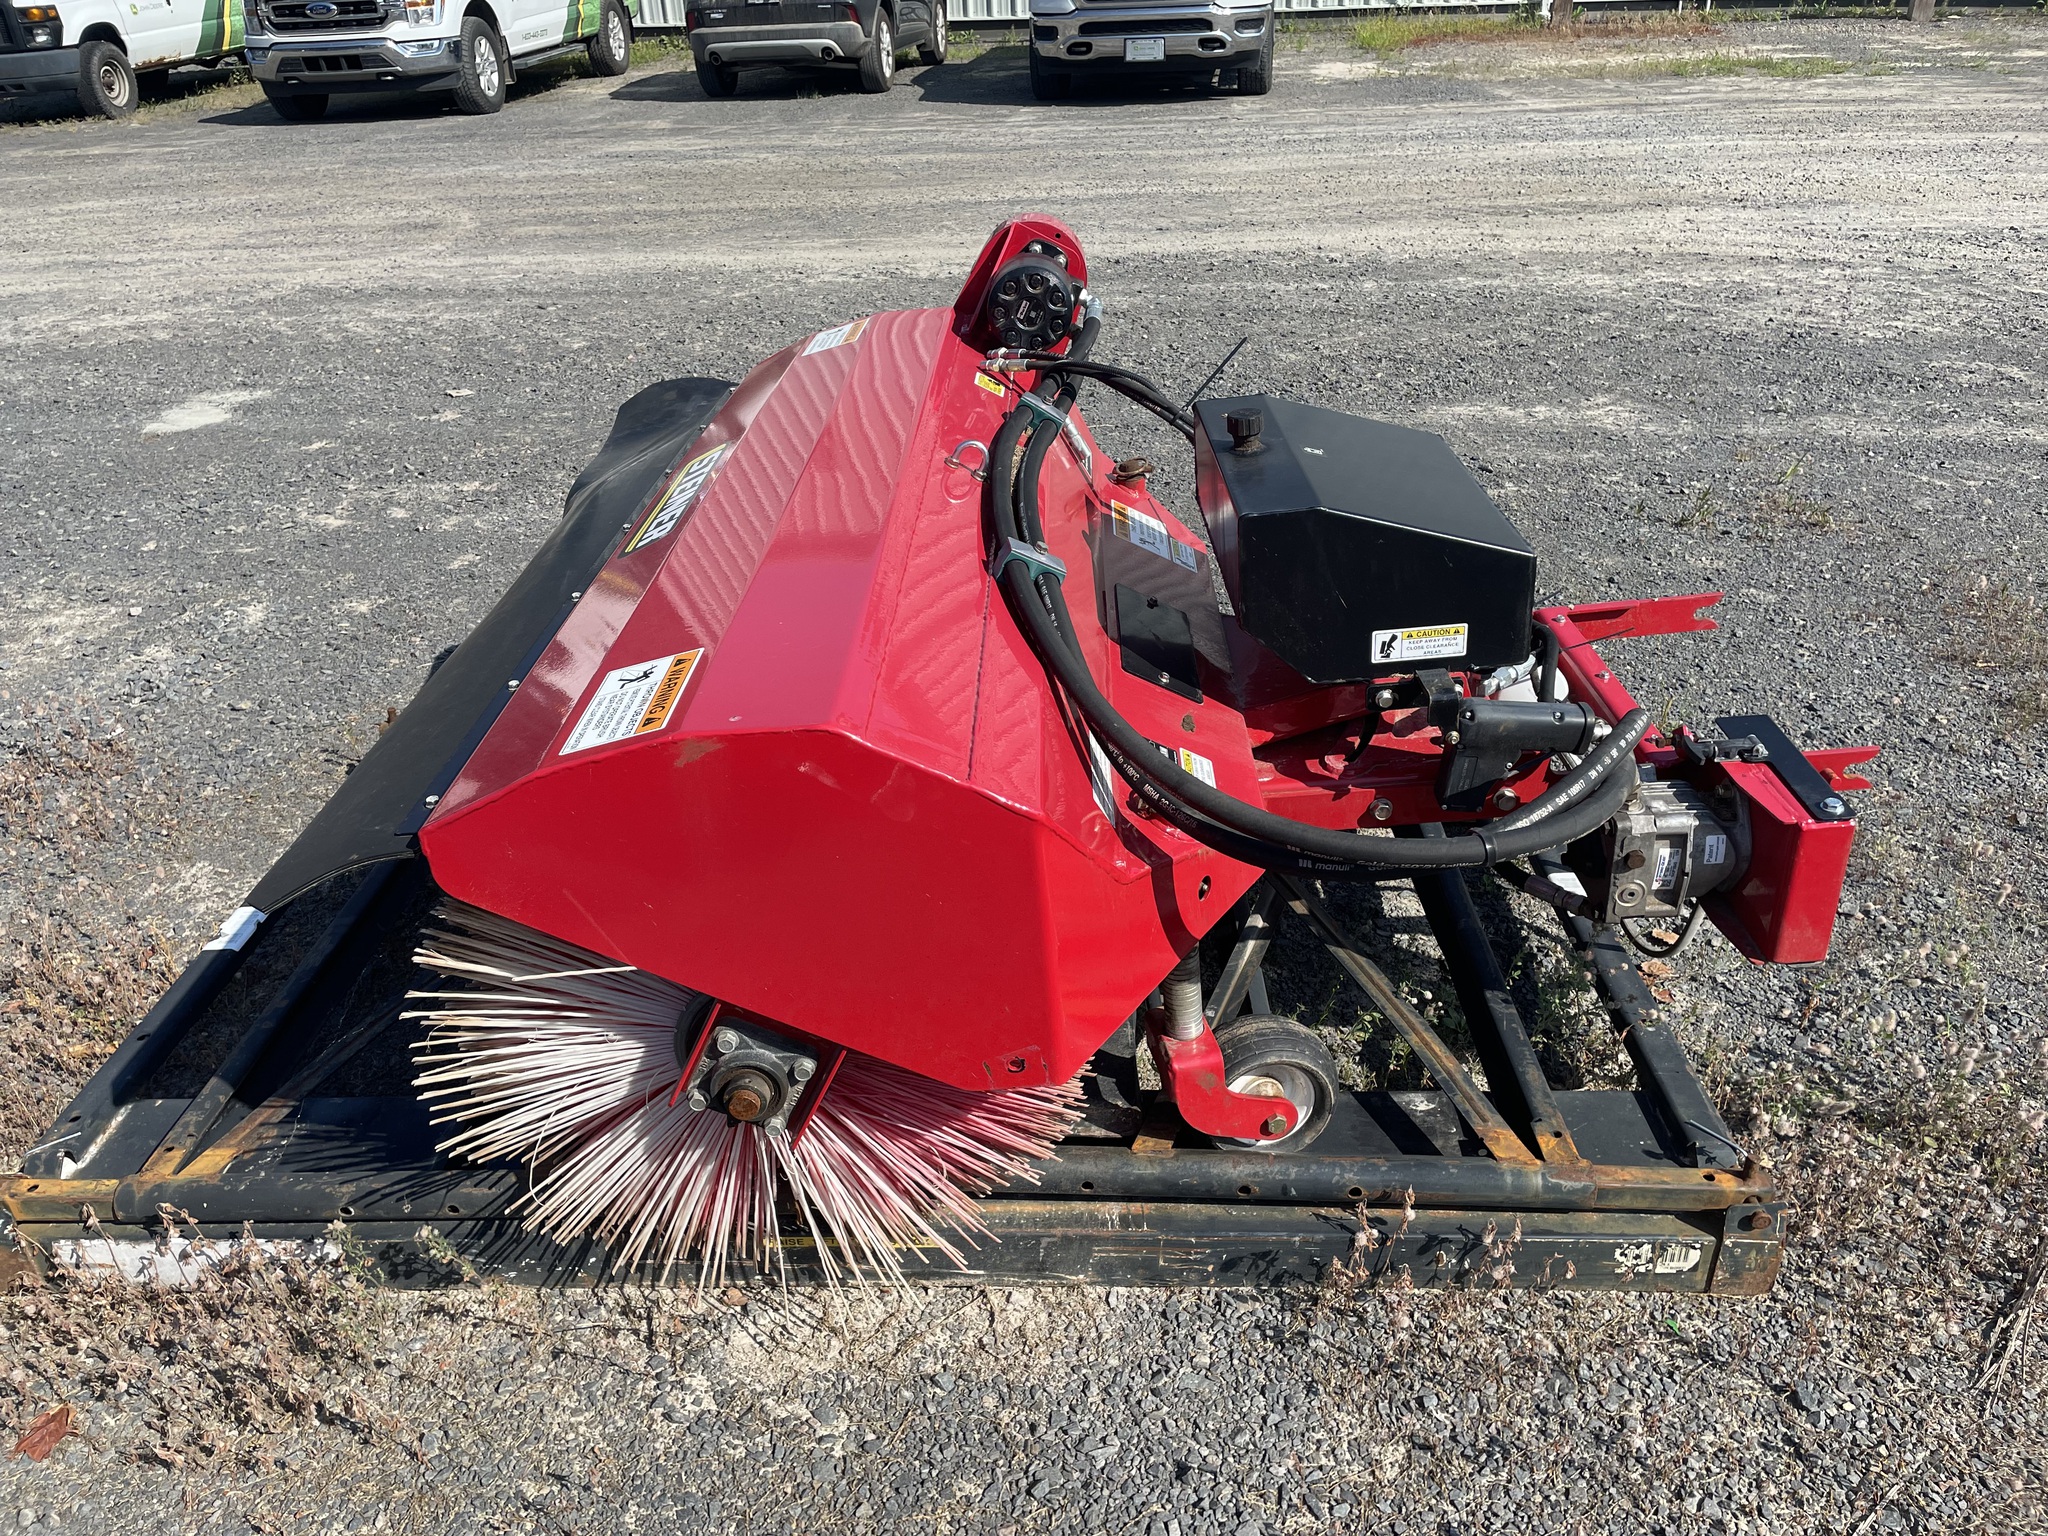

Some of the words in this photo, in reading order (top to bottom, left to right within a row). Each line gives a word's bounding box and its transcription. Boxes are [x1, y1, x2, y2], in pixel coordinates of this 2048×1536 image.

[635, 450, 722, 548] STEINER
[1416, 628, 1450, 638] CAUTION
[1426, 642, 1459, 650] CLEARANCE
[647, 665, 686, 715] WARNING
[620, 707, 644, 736] OBJECTS
[1122, 763, 1140, 782] +100°C
[1143, 784, 1160, 800] MSHA
[1531, 804, 1554, 822] 18752-A
[1556, 794, 1570, 806] SAE
[1568, 780, 1586, 797] 100R17
[1588, 770, 1598, 780] DN
